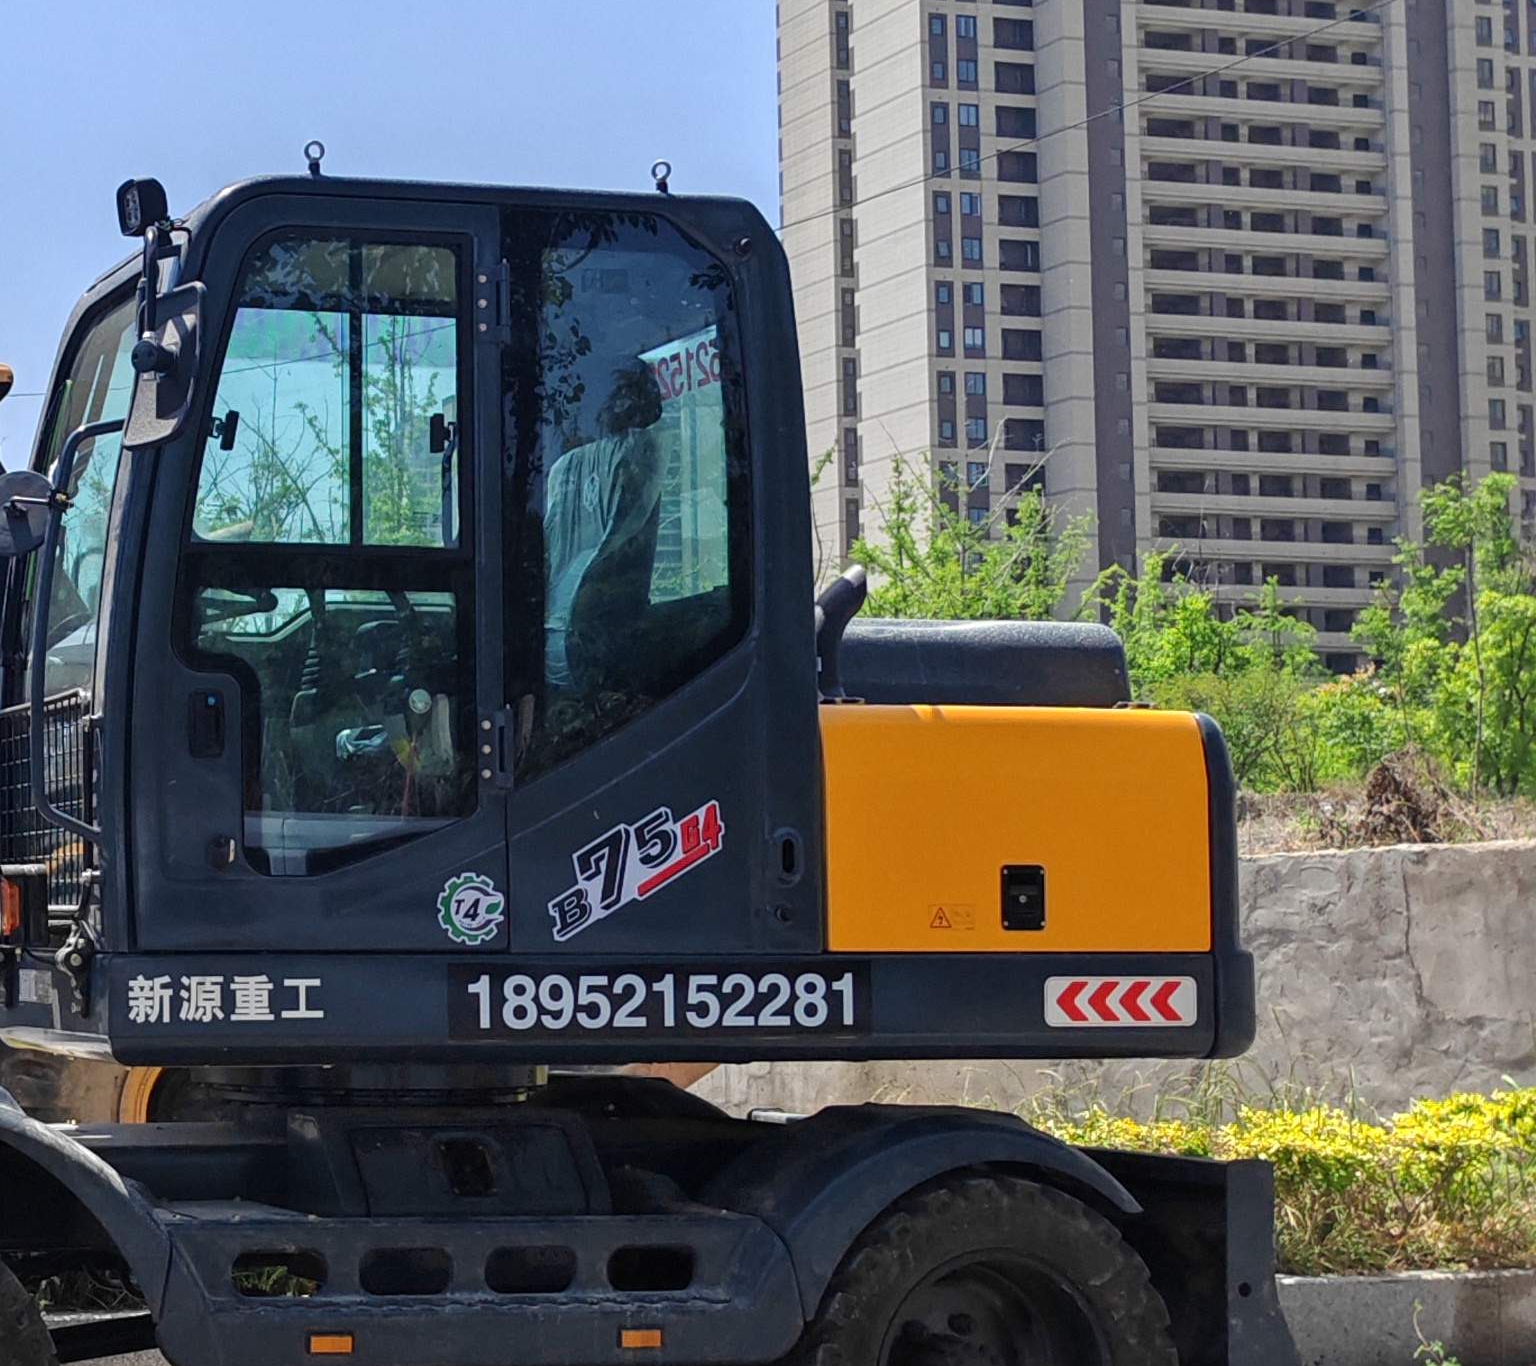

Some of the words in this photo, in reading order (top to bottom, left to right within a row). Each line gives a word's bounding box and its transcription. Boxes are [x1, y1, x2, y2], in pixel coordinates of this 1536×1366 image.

[454, 897, 481, 922] T4
[127, 974, 325, 1024] 新源重工
[466, 971, 855, 1030] 18952152281
